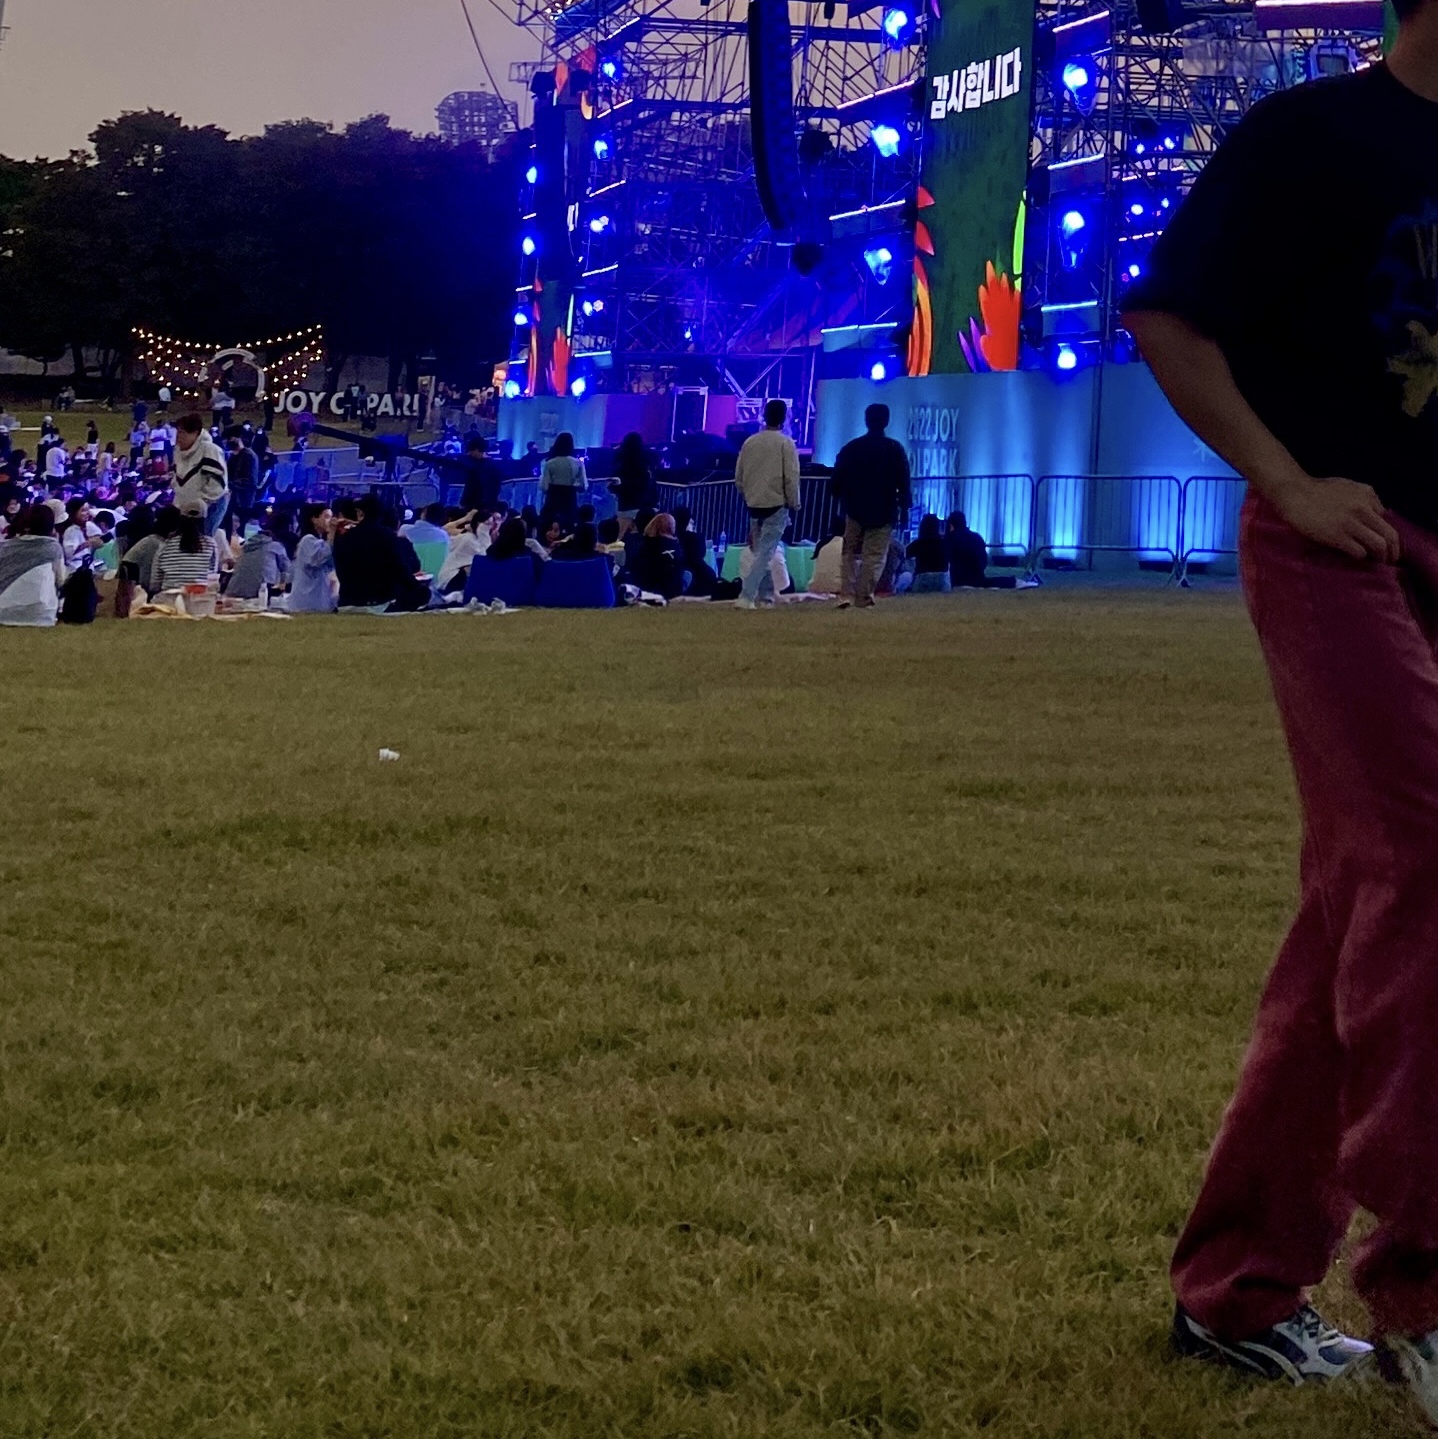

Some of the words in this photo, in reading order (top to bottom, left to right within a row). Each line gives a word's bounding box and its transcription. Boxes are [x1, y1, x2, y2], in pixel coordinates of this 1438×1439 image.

[930, 46, 1022, 119] 감사합니다
[273, 390, 327, 414] JOY
[933, 408, 959, 442] JOY
